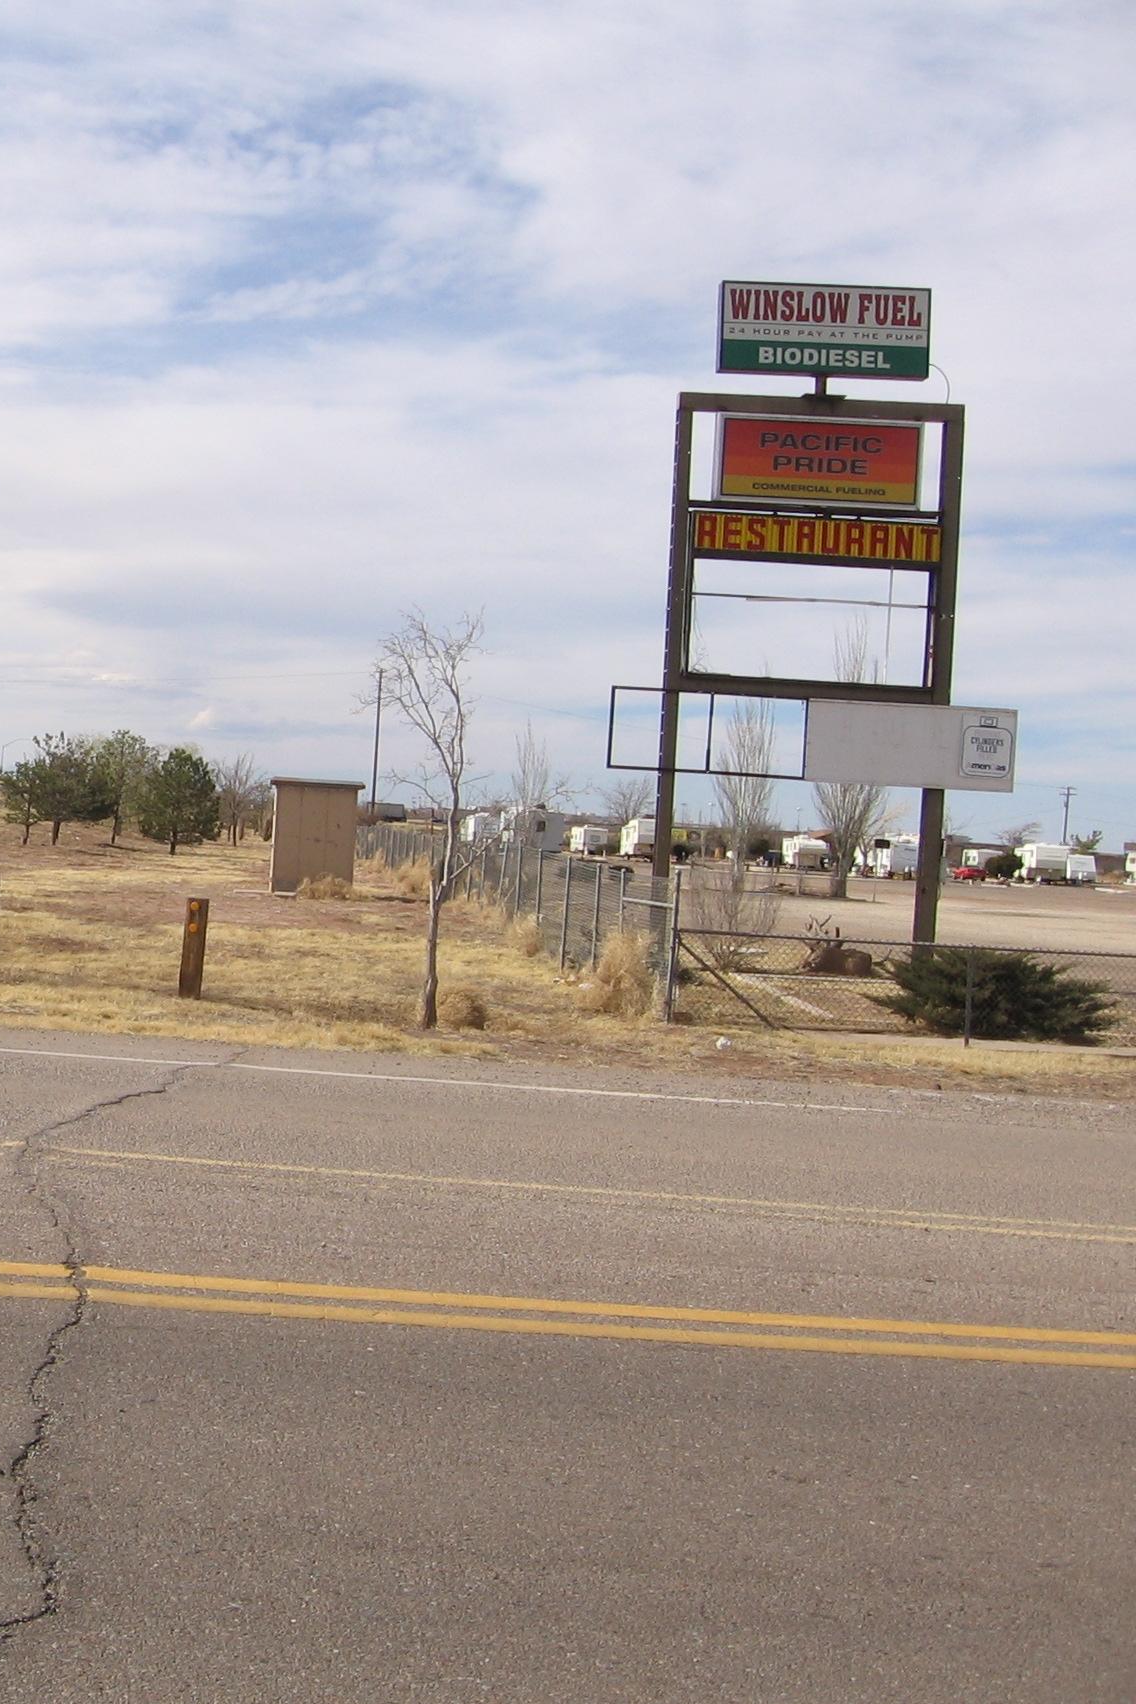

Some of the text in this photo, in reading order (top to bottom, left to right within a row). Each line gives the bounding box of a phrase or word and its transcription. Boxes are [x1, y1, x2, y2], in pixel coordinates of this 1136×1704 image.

[730, 288, 922, 327] WINSLOW FUEL
[729, 327, 923, 342] 24 HOUR PAY AT THE PUMP
[758, 346, 891, 369] BIODIESEL
[760, 431, 882, 454] PACIFIC
[773, 455, 868, 476] PRIDE
[752, 482, 886, 497] COMMERCIAL FUELING
[698, 515, 939, 561] RESTAURANT
